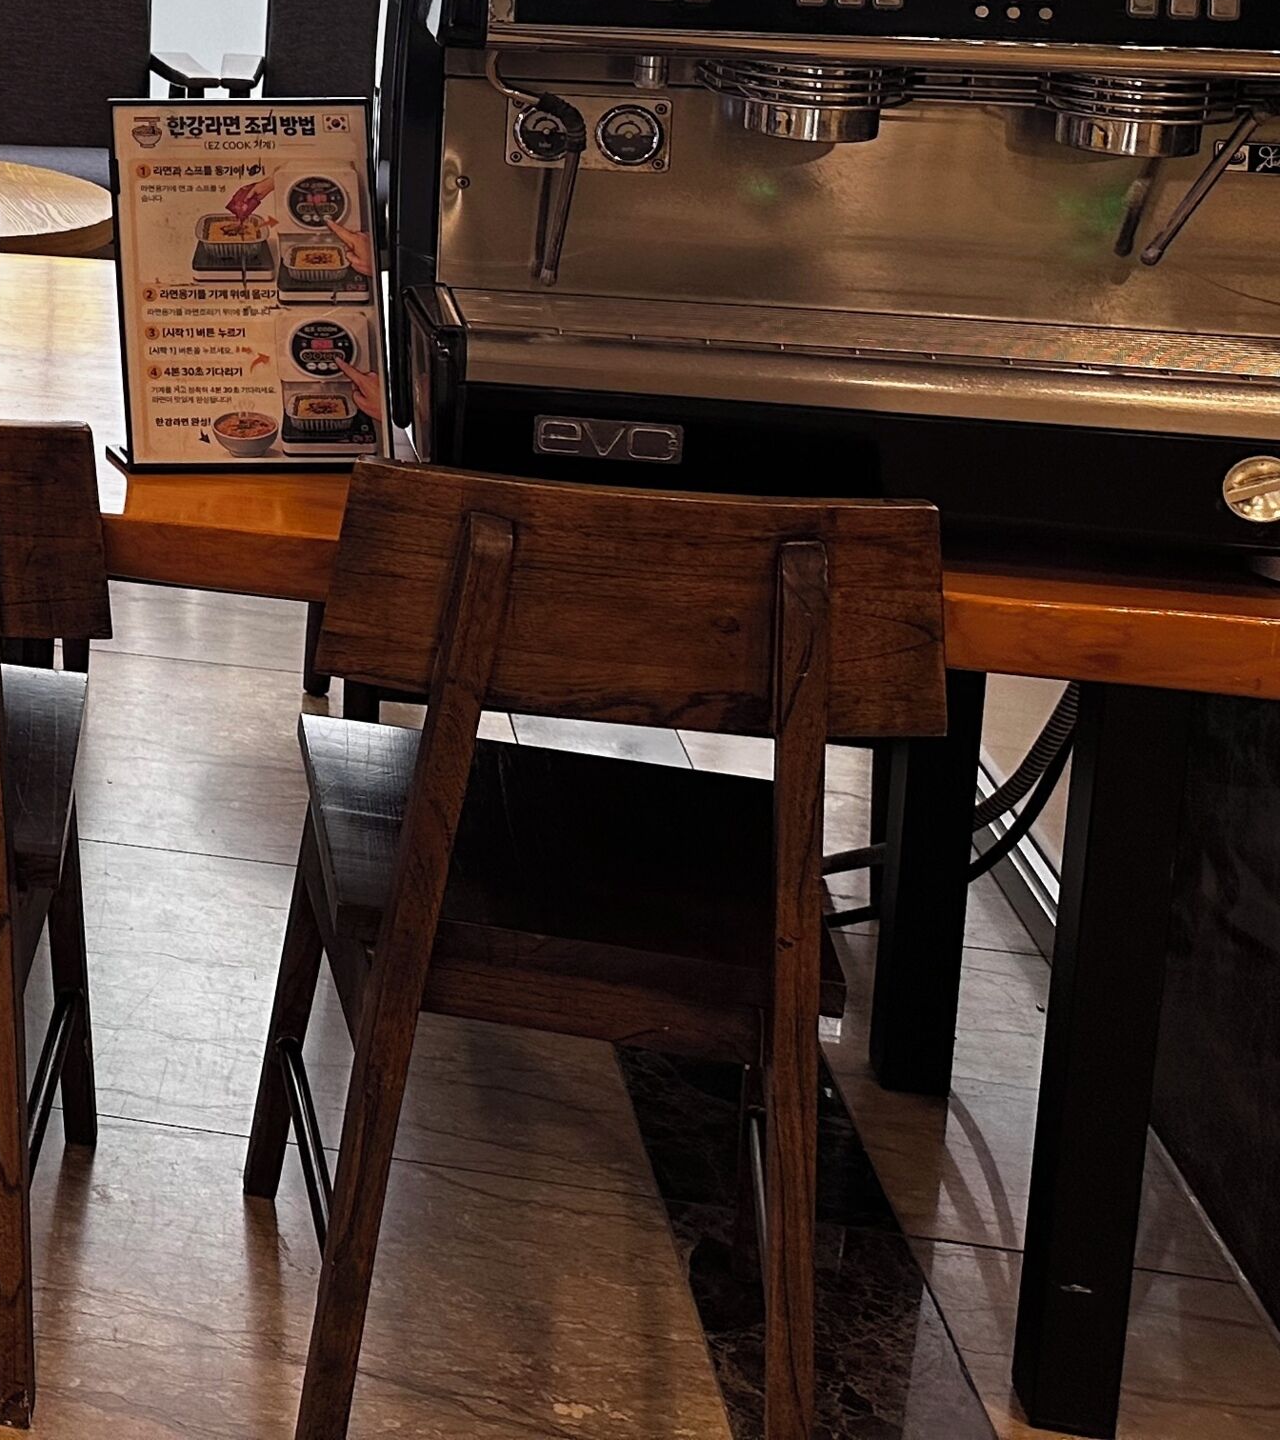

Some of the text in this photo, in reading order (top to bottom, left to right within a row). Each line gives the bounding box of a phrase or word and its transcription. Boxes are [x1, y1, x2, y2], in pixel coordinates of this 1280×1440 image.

[166, 115, 316, 137] 한강라면 조리 방법
[222, 140, 251, 150] COOK
[153, 166, 182, 177] 라면과
[185, 165, 212, 176] 스프를
[160, 289, 206, 300] 라면용기를
[208, 289, 228, 300] 기계
[196, 328, 215, 337] 버튼
[182, 367, 204, 377] 30초
[206, 367, 243, 377] 기다리기
[155, 417, 189, 427] 한강라면
